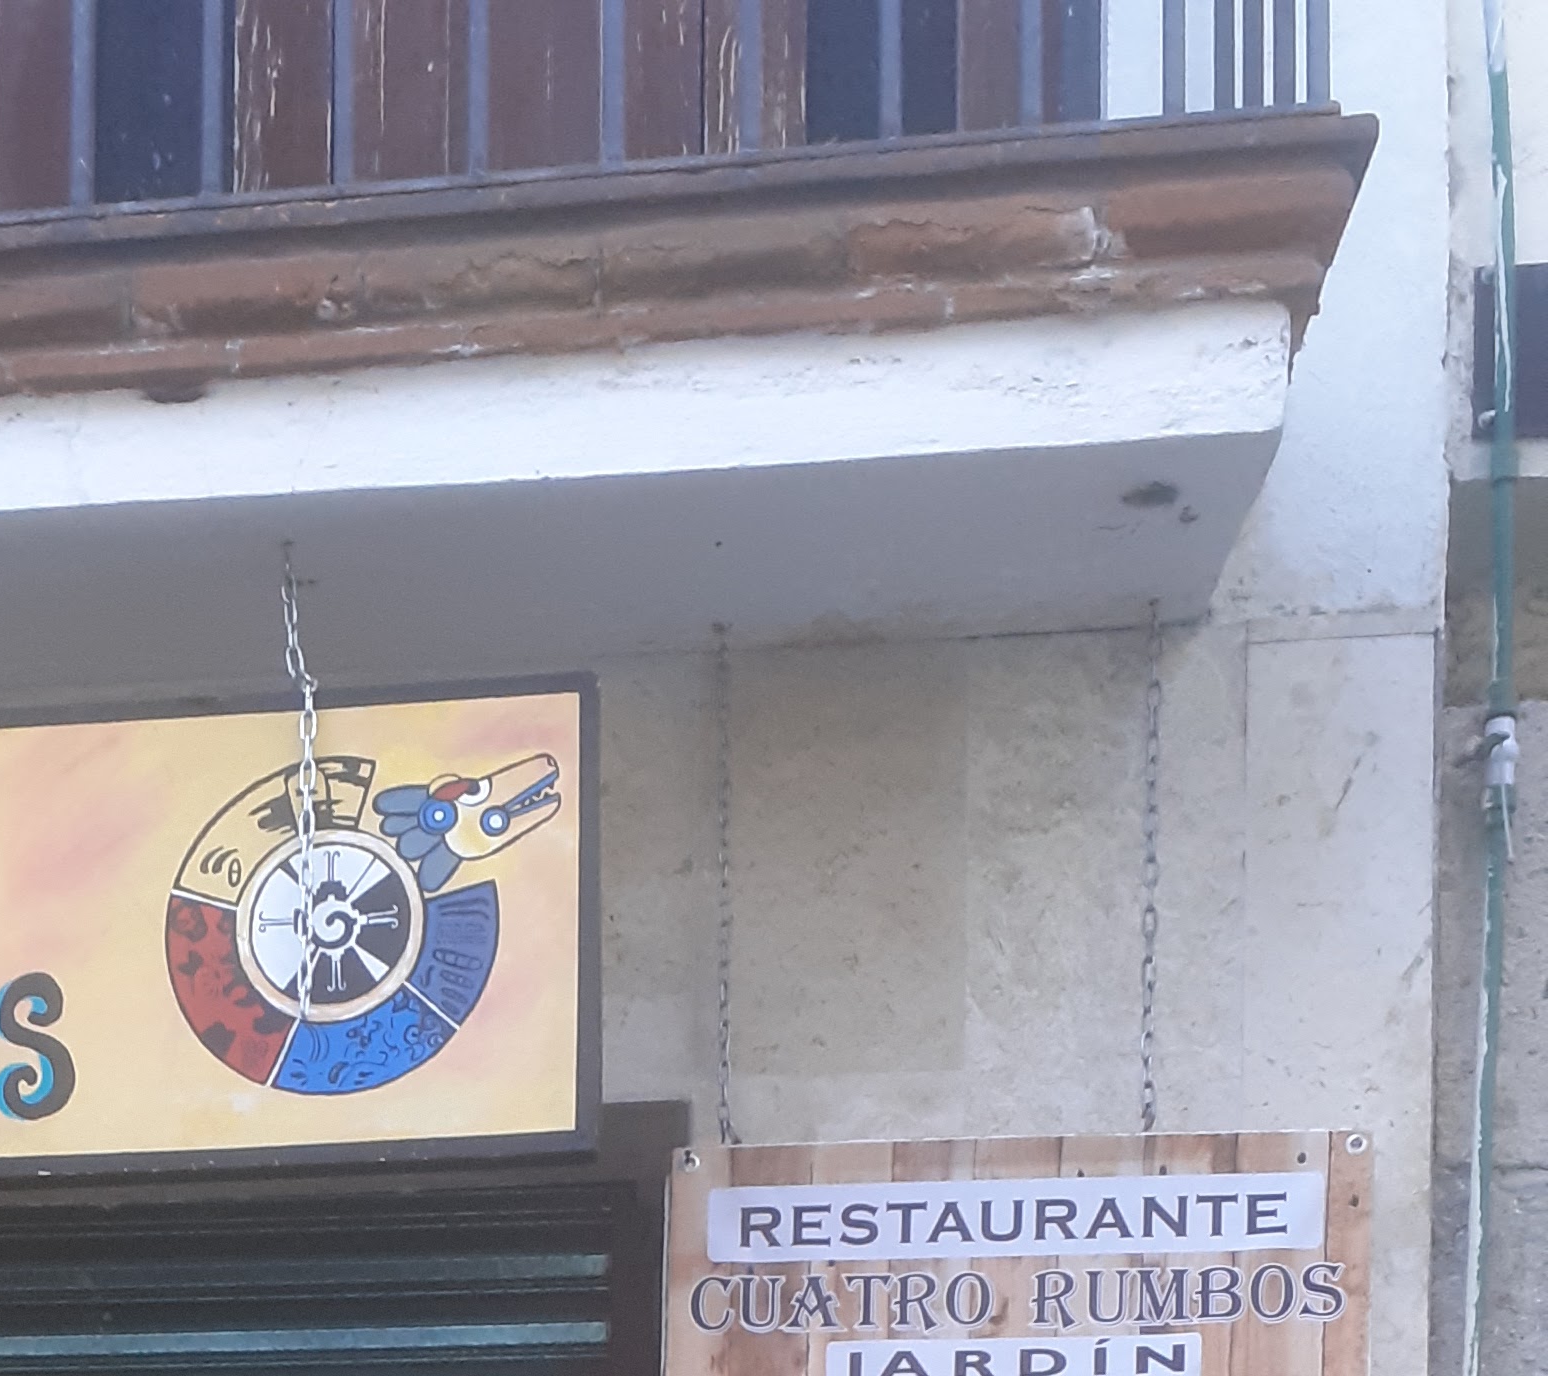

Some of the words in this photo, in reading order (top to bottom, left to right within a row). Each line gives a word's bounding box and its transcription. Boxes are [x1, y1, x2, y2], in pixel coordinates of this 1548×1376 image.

[738, 1192, 1288, 1249] RESTAURANTE
[690, 1271, 994, 1333] CUATRO
[1031, 1262, 1346, 1328] RUMBOS
